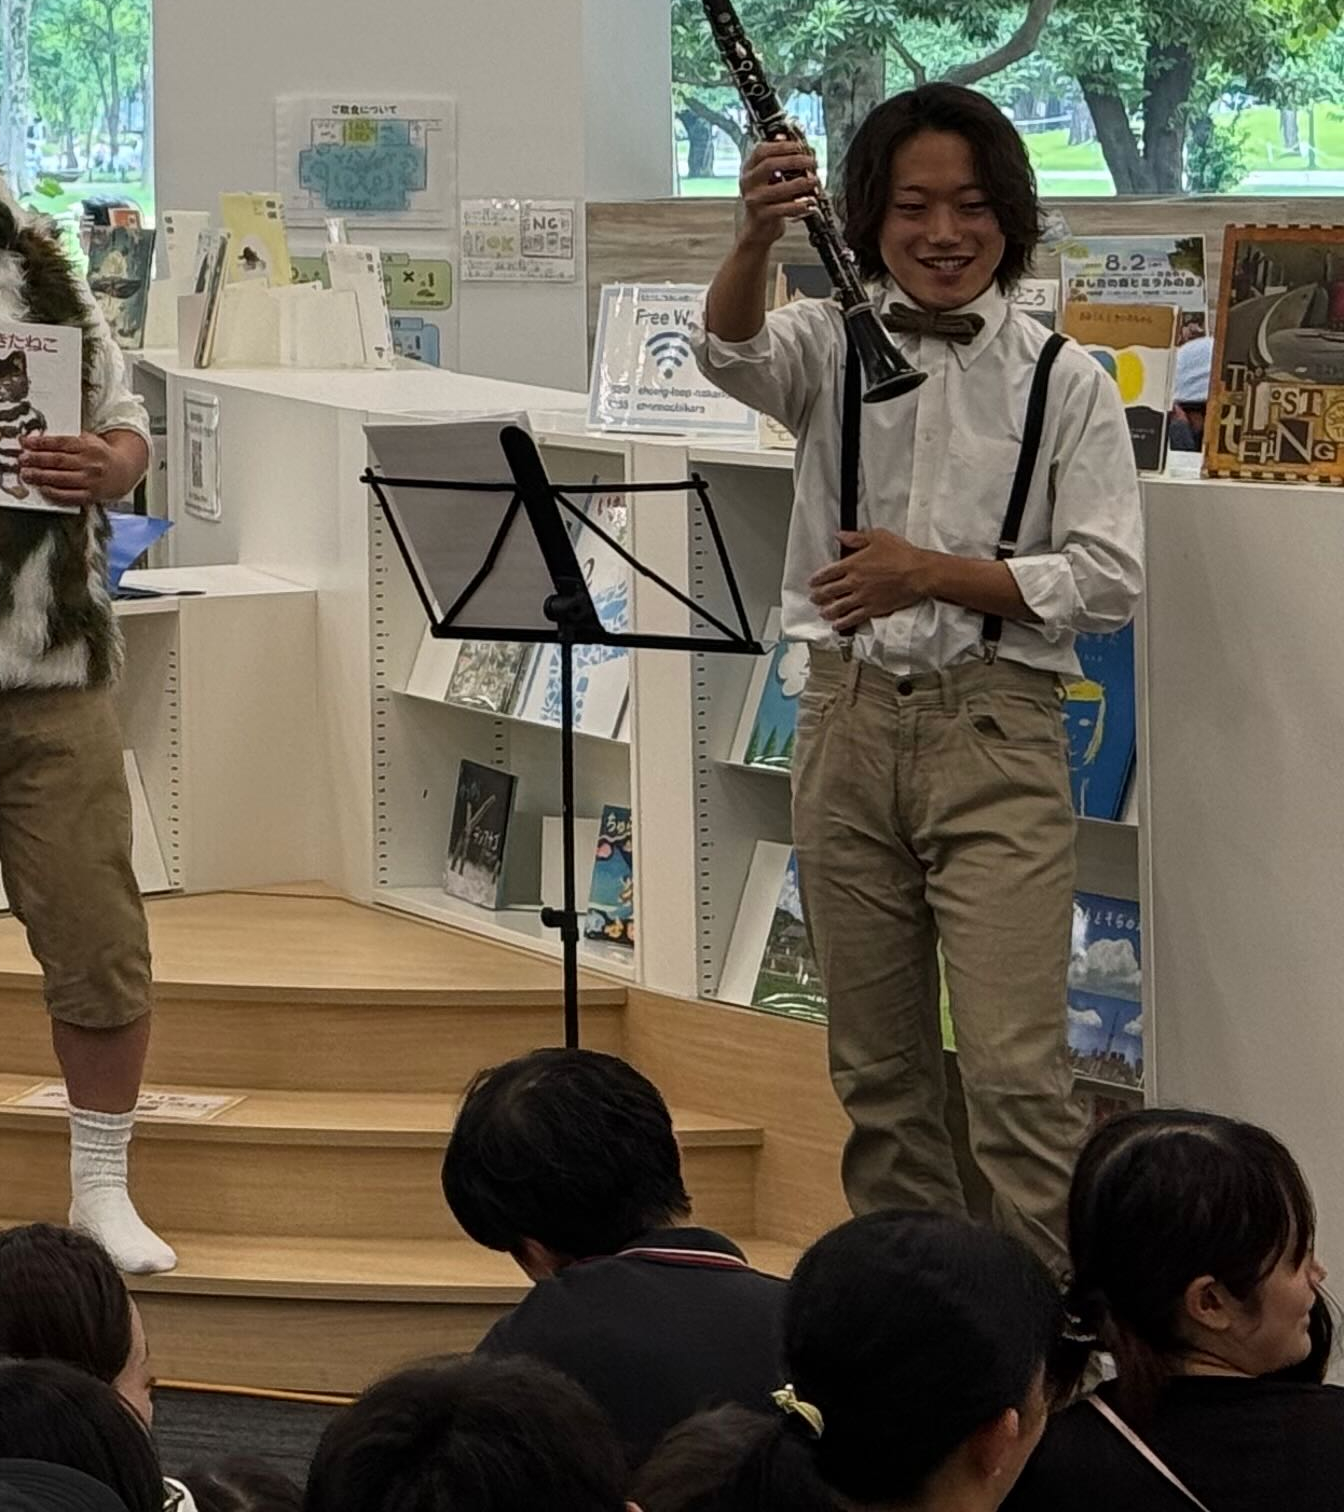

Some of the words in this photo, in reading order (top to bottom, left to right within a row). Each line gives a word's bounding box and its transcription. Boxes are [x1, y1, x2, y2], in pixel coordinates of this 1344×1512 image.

[332, 105, 398, 115] ご飲食について
[1105, 253, 1146, 271] 8.2
[636, 308, 670, 326] Free
